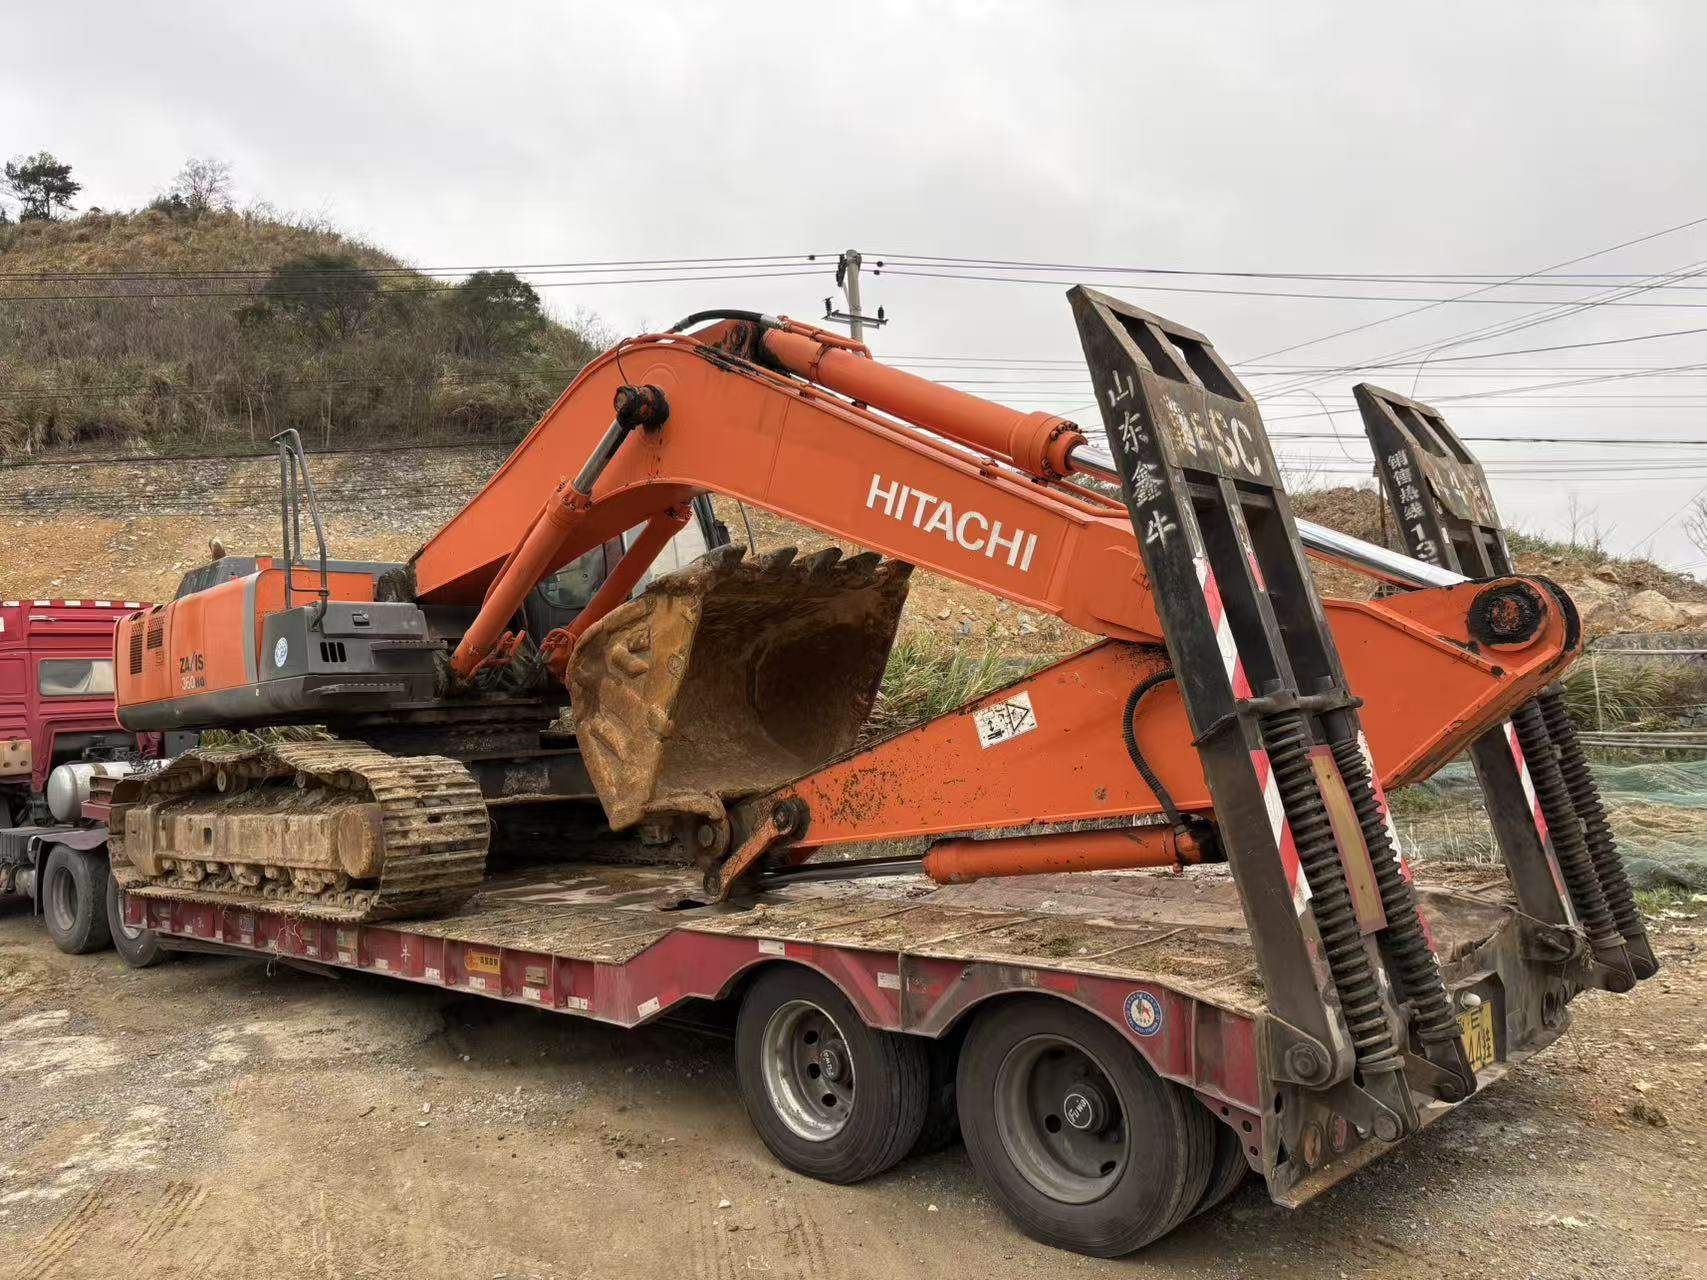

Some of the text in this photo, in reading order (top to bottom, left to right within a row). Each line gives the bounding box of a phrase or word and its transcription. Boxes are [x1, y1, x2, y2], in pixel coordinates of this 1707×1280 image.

[866, 473, 1038, 572] HITACHI
[1108, 370, 1176, 548] 山东鑫牛
